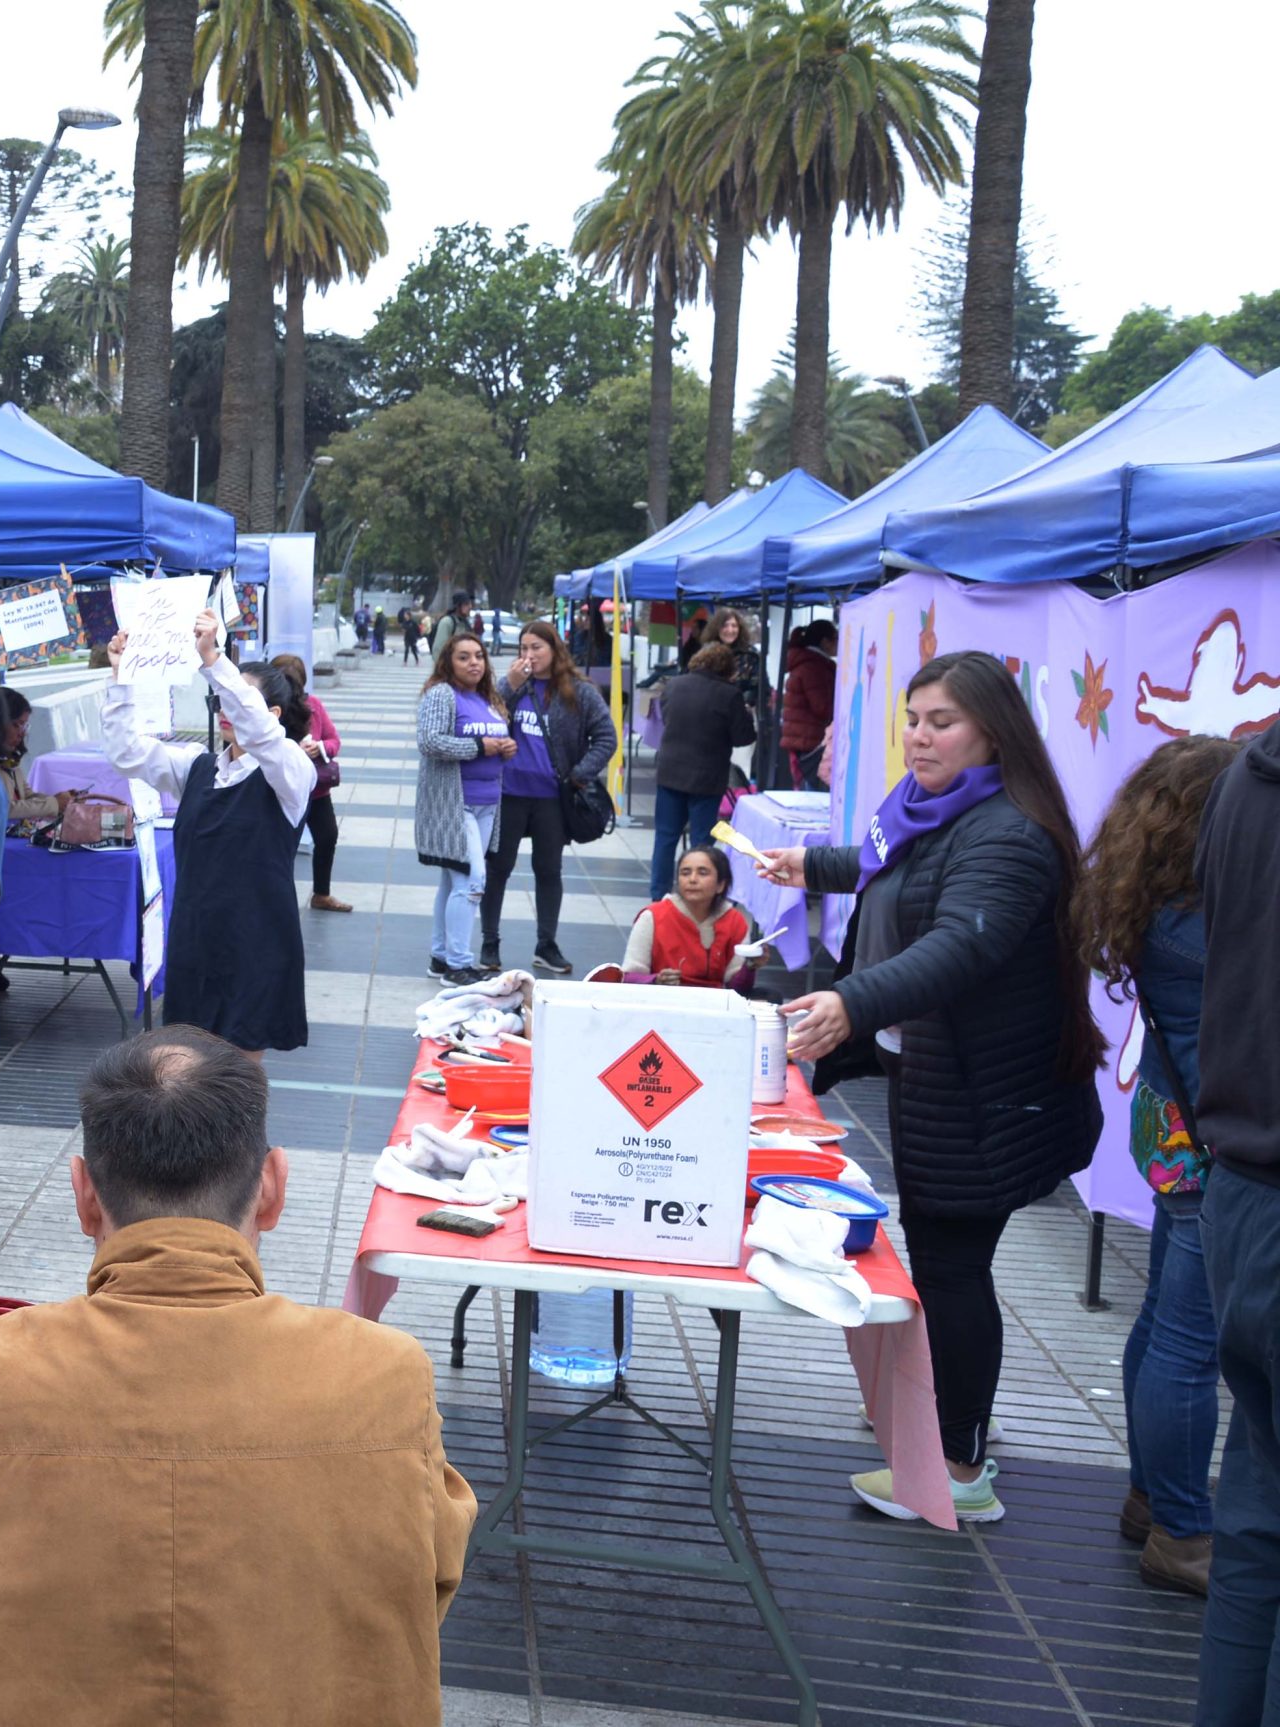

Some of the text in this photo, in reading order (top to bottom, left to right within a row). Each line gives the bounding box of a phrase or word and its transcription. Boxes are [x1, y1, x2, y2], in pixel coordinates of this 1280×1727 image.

[4, 606, 58, 625] Matrimonio Civil
[638, 1077, 661, 1085] GASES
[627, 1084, 672, 1093] INFLAMABLES
[644, 1095, 654, 1107] 2
[622, 1136, 672, 1149] UN 1950
[676, 1153, 698, 1164] Foam)
[571, 1191, 635, 1202] Espuma Poliuretano
[581, 1198, 598, 1206] Beige
